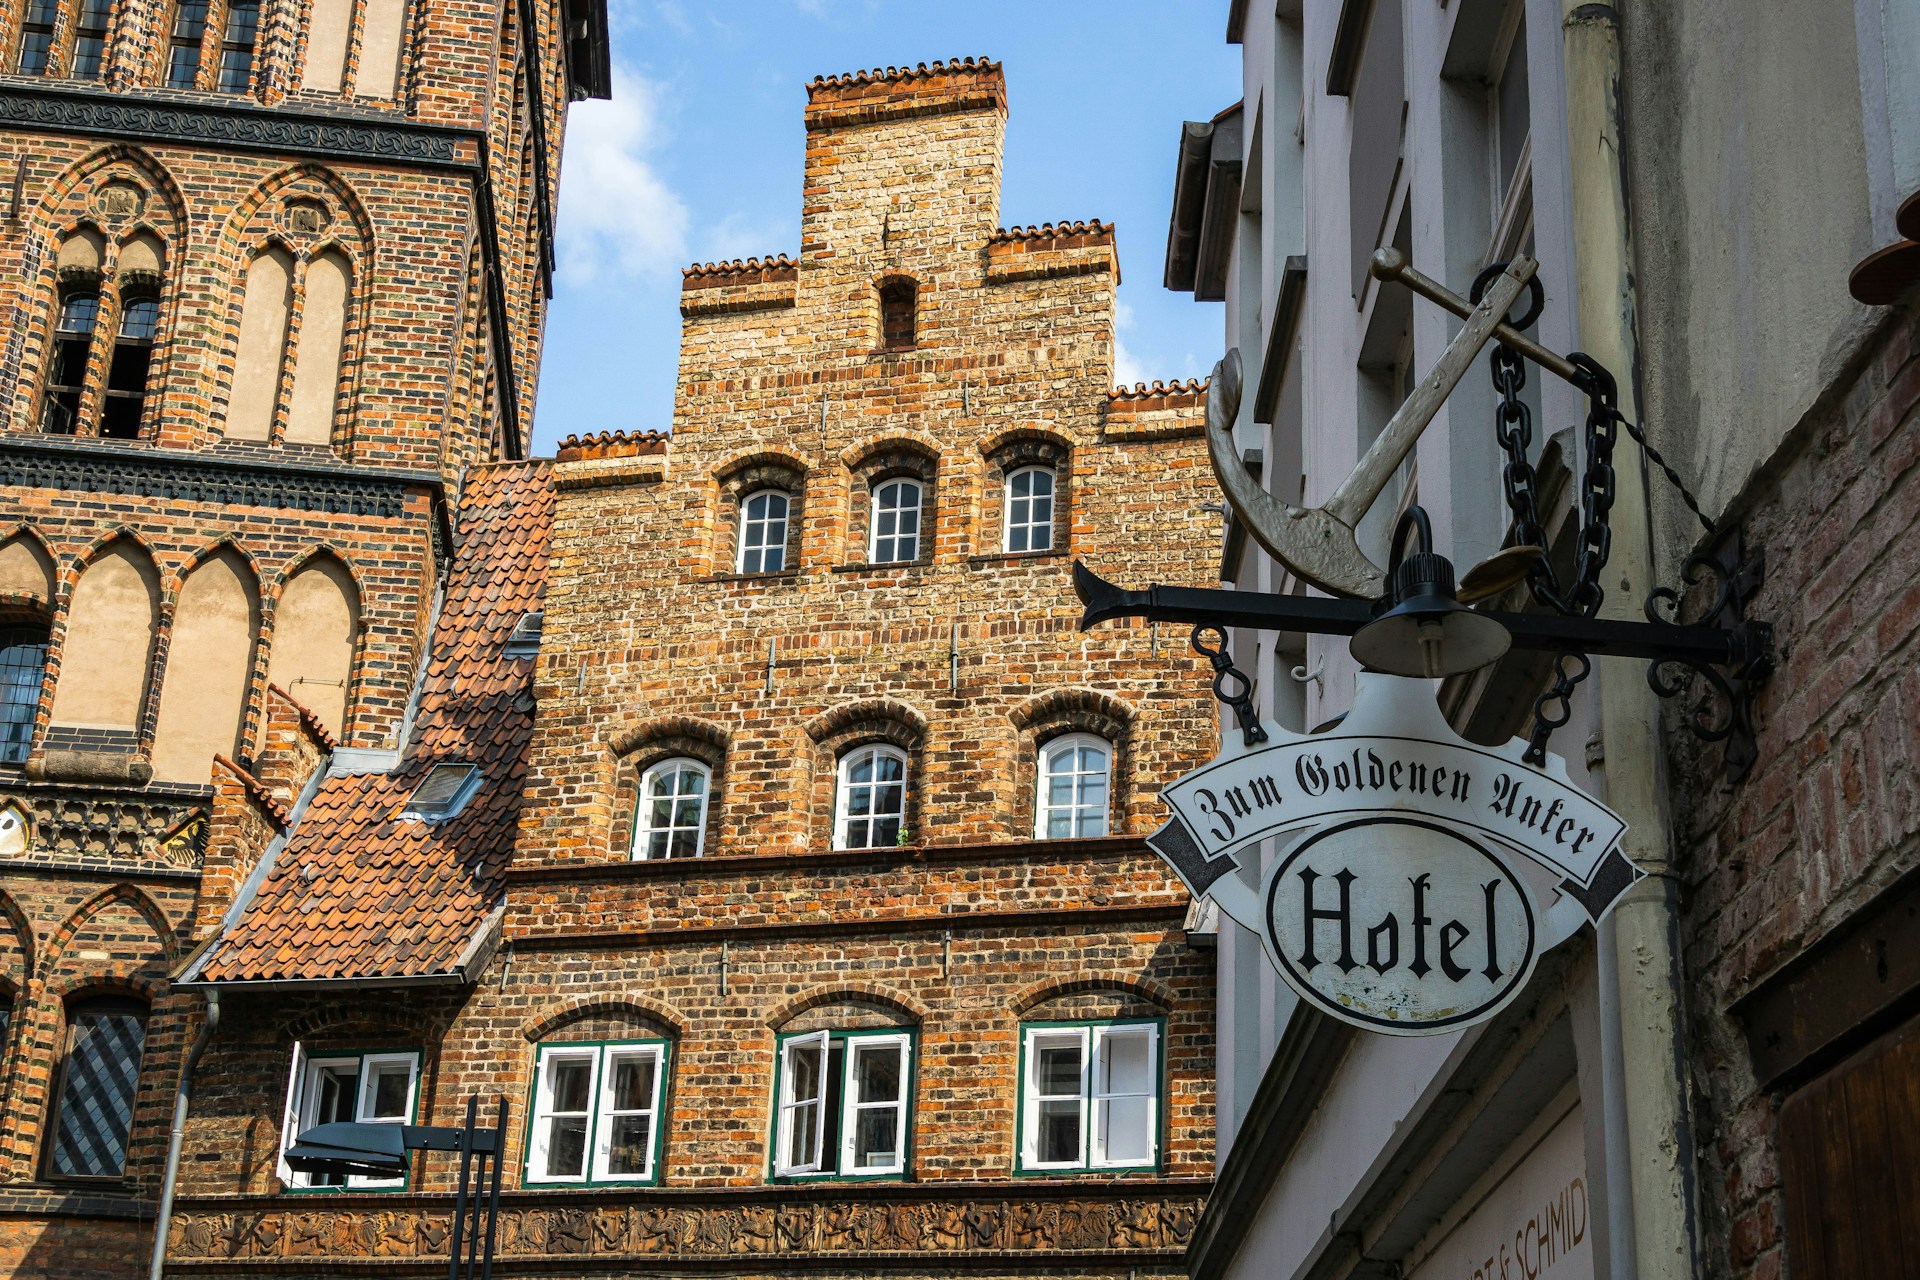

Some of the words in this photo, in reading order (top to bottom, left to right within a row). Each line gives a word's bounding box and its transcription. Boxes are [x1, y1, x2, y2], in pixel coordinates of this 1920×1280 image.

[1194, 774, 1283, 842] Zum
[1295, 747, 1471, 803] Goldenen
[1488, 773, 1595, 854] Anker
[1297, 865, 1505, 985] Hotel
[1516, 1177, 1586, 1280] SCHMID
